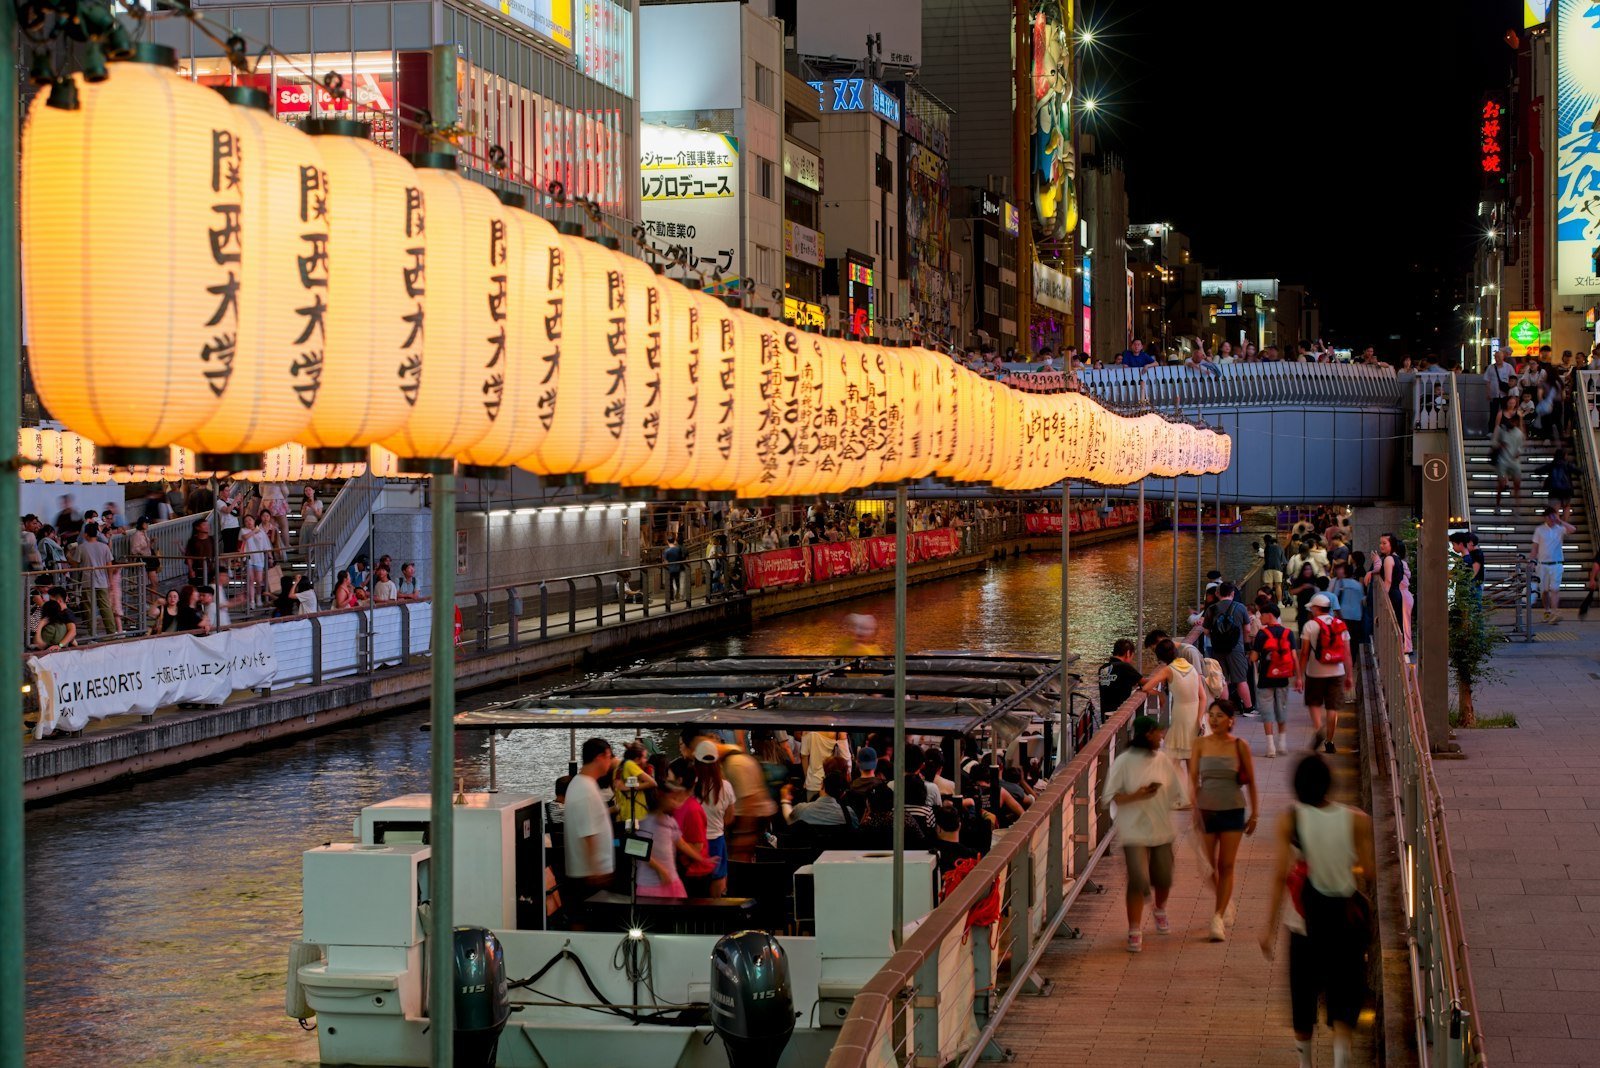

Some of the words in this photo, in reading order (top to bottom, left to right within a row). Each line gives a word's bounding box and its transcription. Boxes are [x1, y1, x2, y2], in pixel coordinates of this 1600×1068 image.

[87, 671, 143, 699] RESORTS
[462, 984, 486, 994] 115
[752, 990, 776, 1000] 115
